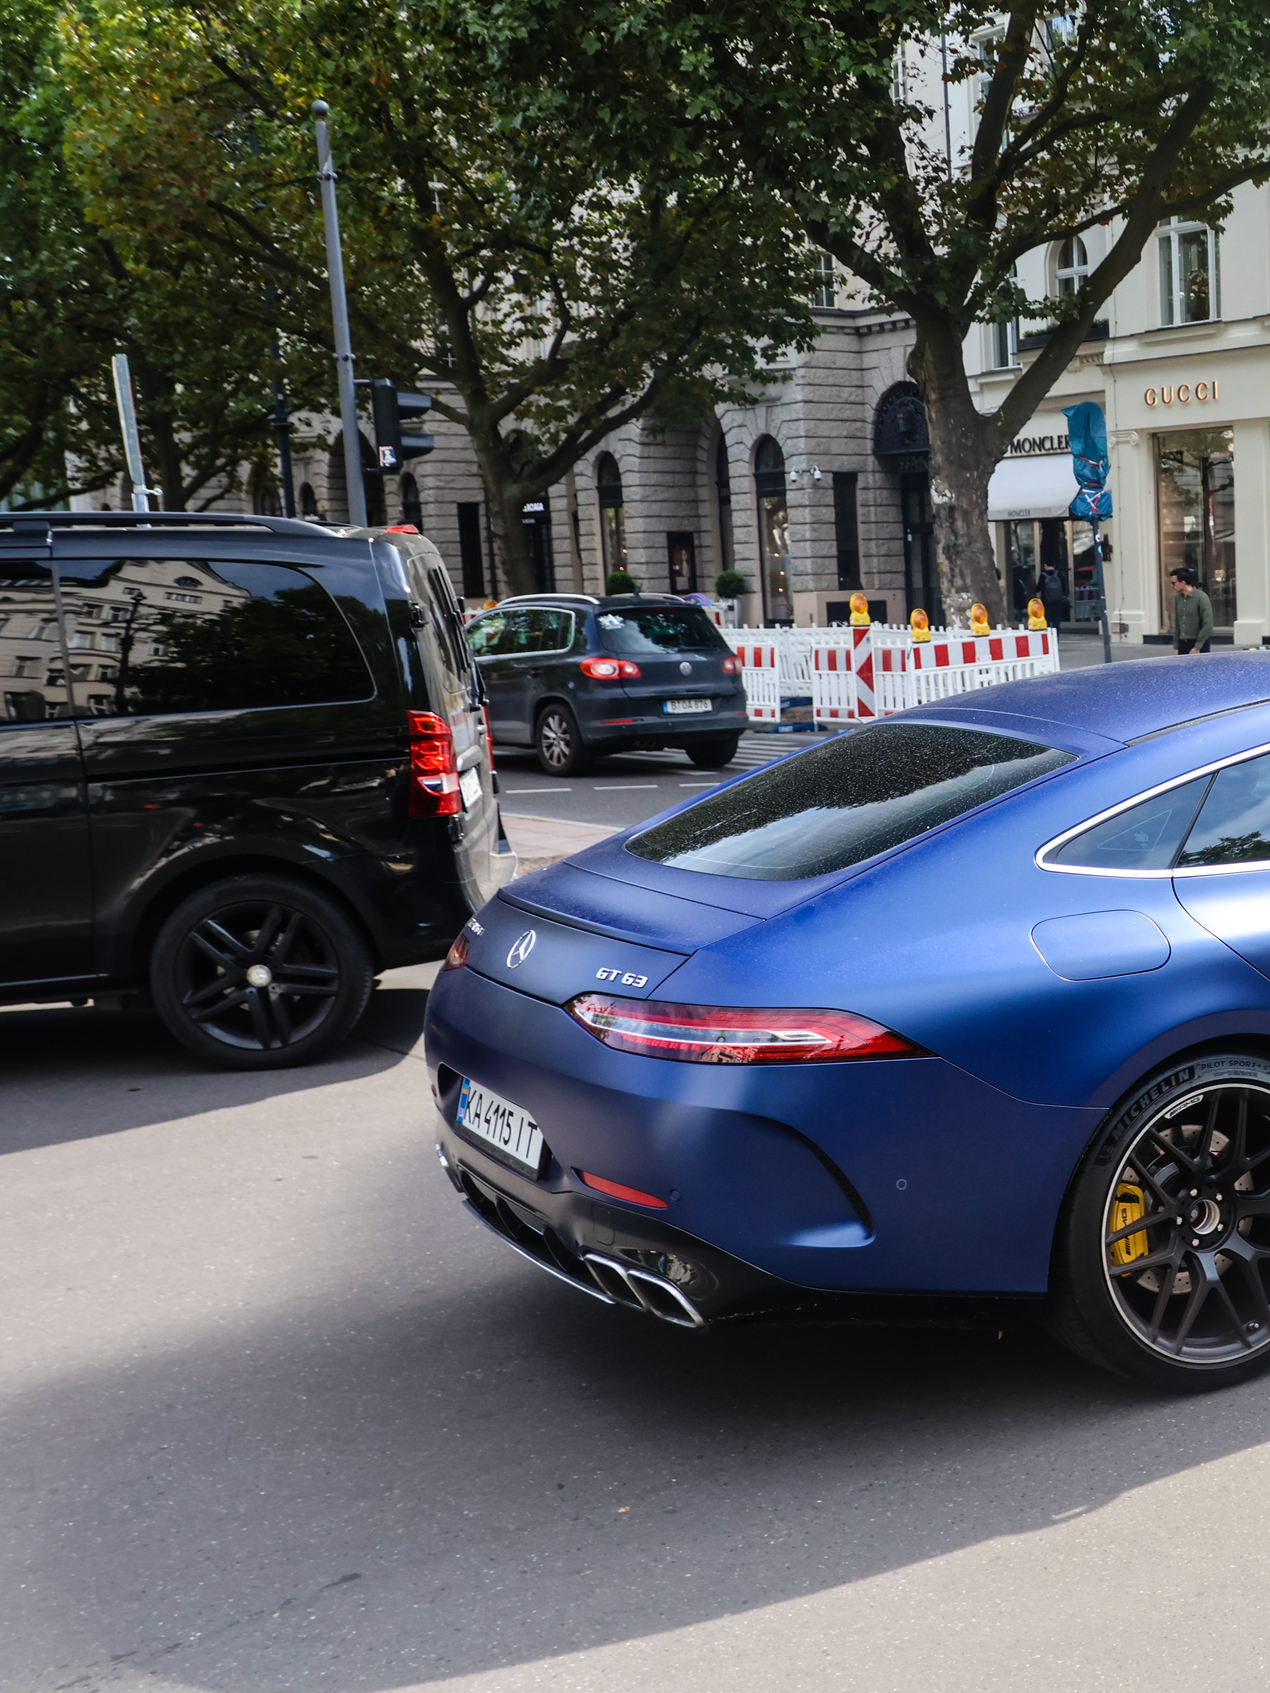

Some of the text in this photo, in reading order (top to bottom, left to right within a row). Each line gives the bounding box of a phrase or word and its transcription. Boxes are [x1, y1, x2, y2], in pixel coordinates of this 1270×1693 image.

[1144, 380, 1219, 407] GUCCI
[1007, 509, 1031, 517] MONCLER
[595, 967, 649, 988] GT 63
[1201, 1060, 1225, 1070] PILOT
[1228, 1060, 1257, 1068] SPORT
[1111, 1068, 1190, 1141] MICHELIN
[464, 1086, 538, 1159] KA 4115 IT
